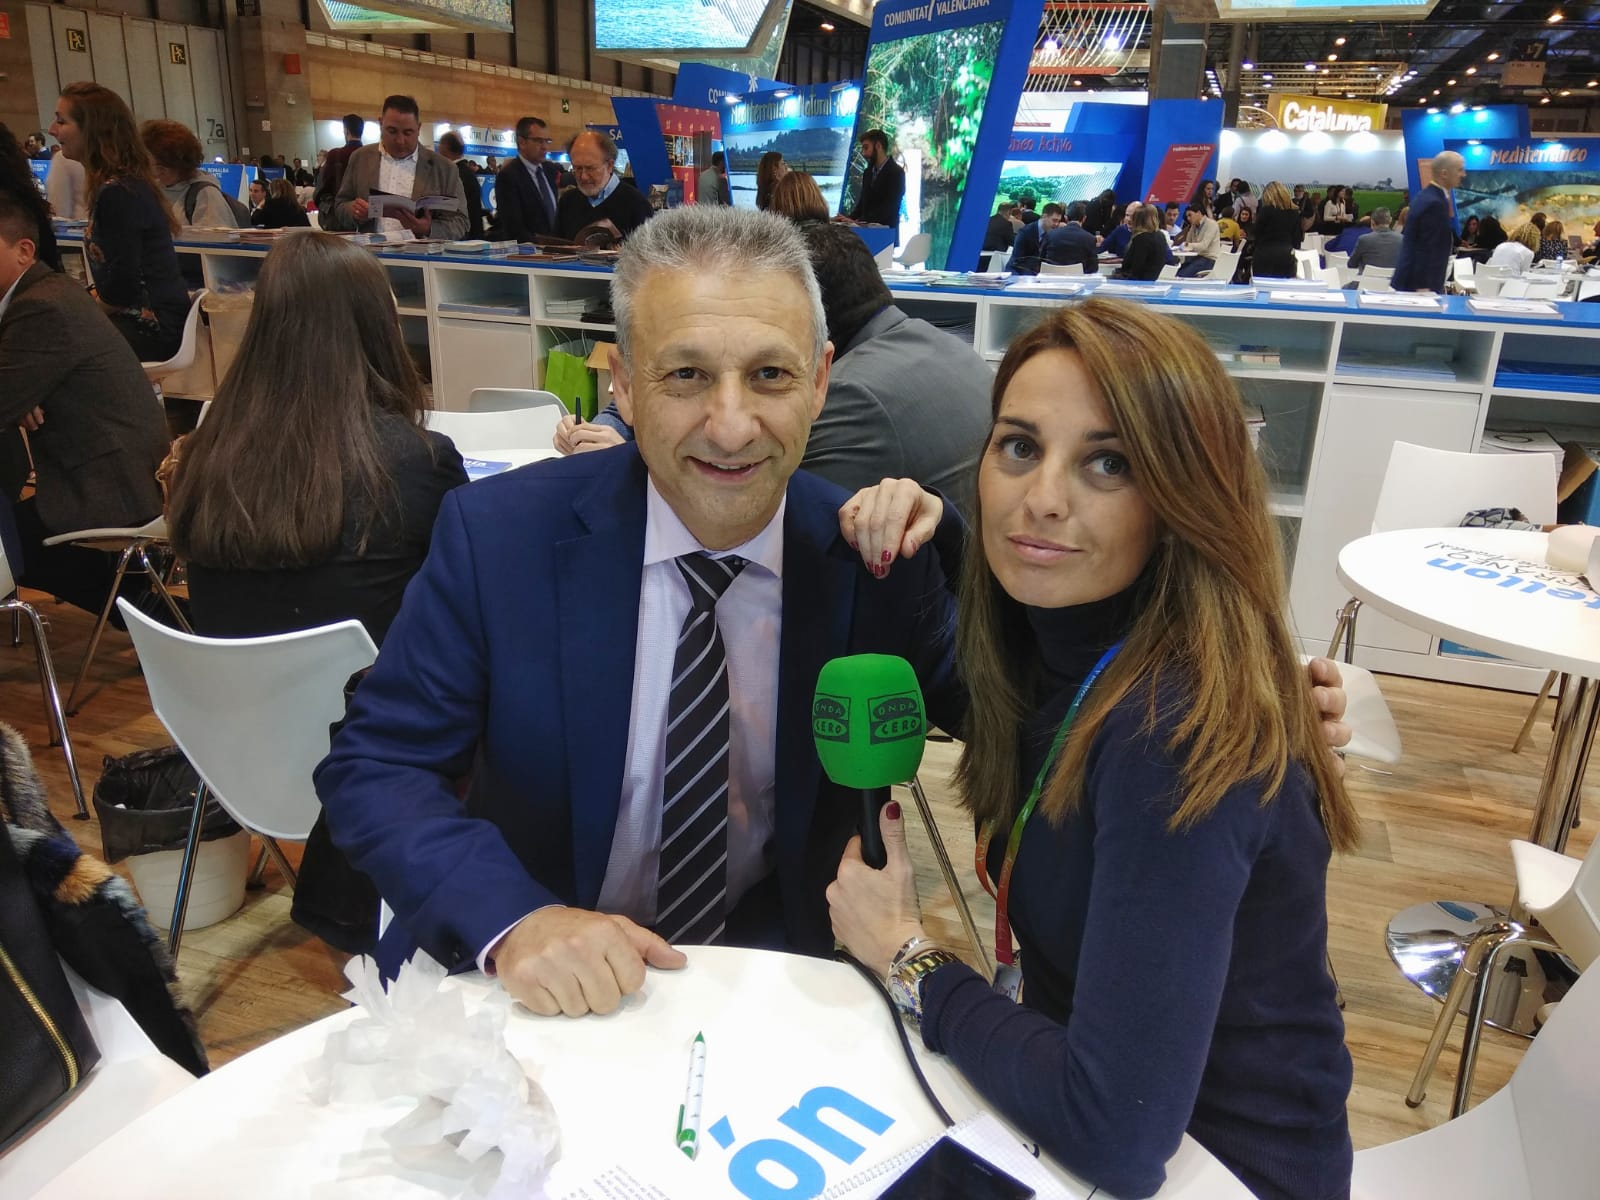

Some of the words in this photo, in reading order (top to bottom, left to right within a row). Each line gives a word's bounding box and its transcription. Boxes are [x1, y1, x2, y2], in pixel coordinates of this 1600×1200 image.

[884, 5, 929, 27] COMUNITAT
[1282, 101, 1372, 131] Catalunya
[206, 118, 225, 138] 7a
[1038, 135, 1072, 152] Activo
[878, 702, 914, 716] ONDA
[815, 721, 842, 734] CERO
[882, 720, 917, 735] CERO
